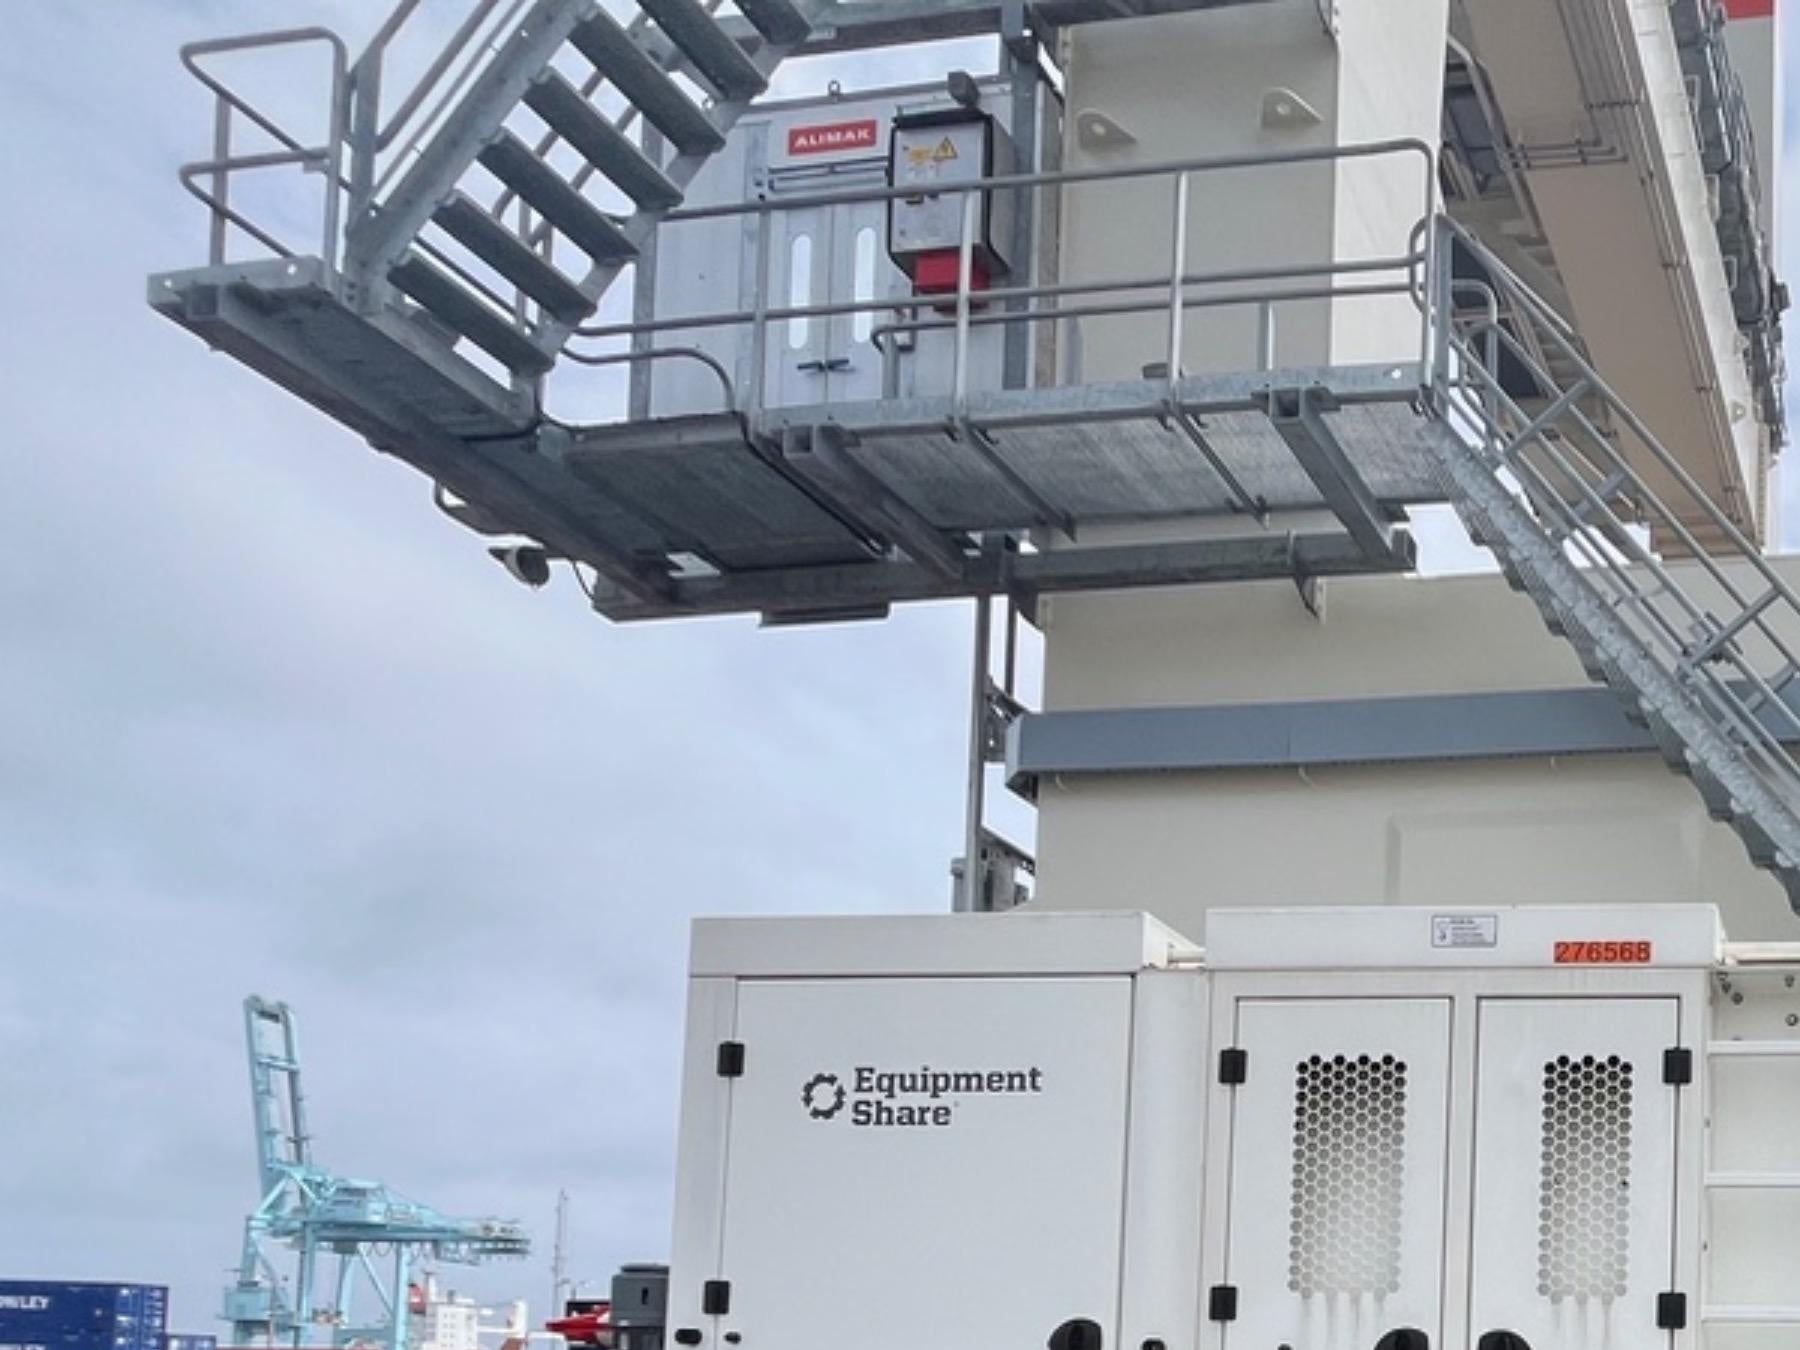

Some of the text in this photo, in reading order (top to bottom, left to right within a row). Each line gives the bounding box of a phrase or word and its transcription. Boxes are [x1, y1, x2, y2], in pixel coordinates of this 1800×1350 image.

[794, 128, 871, 148] ALIMAK
[853, 1065, 1043, 1099] Equipment
[851, 1100, 951, 1126] Share
